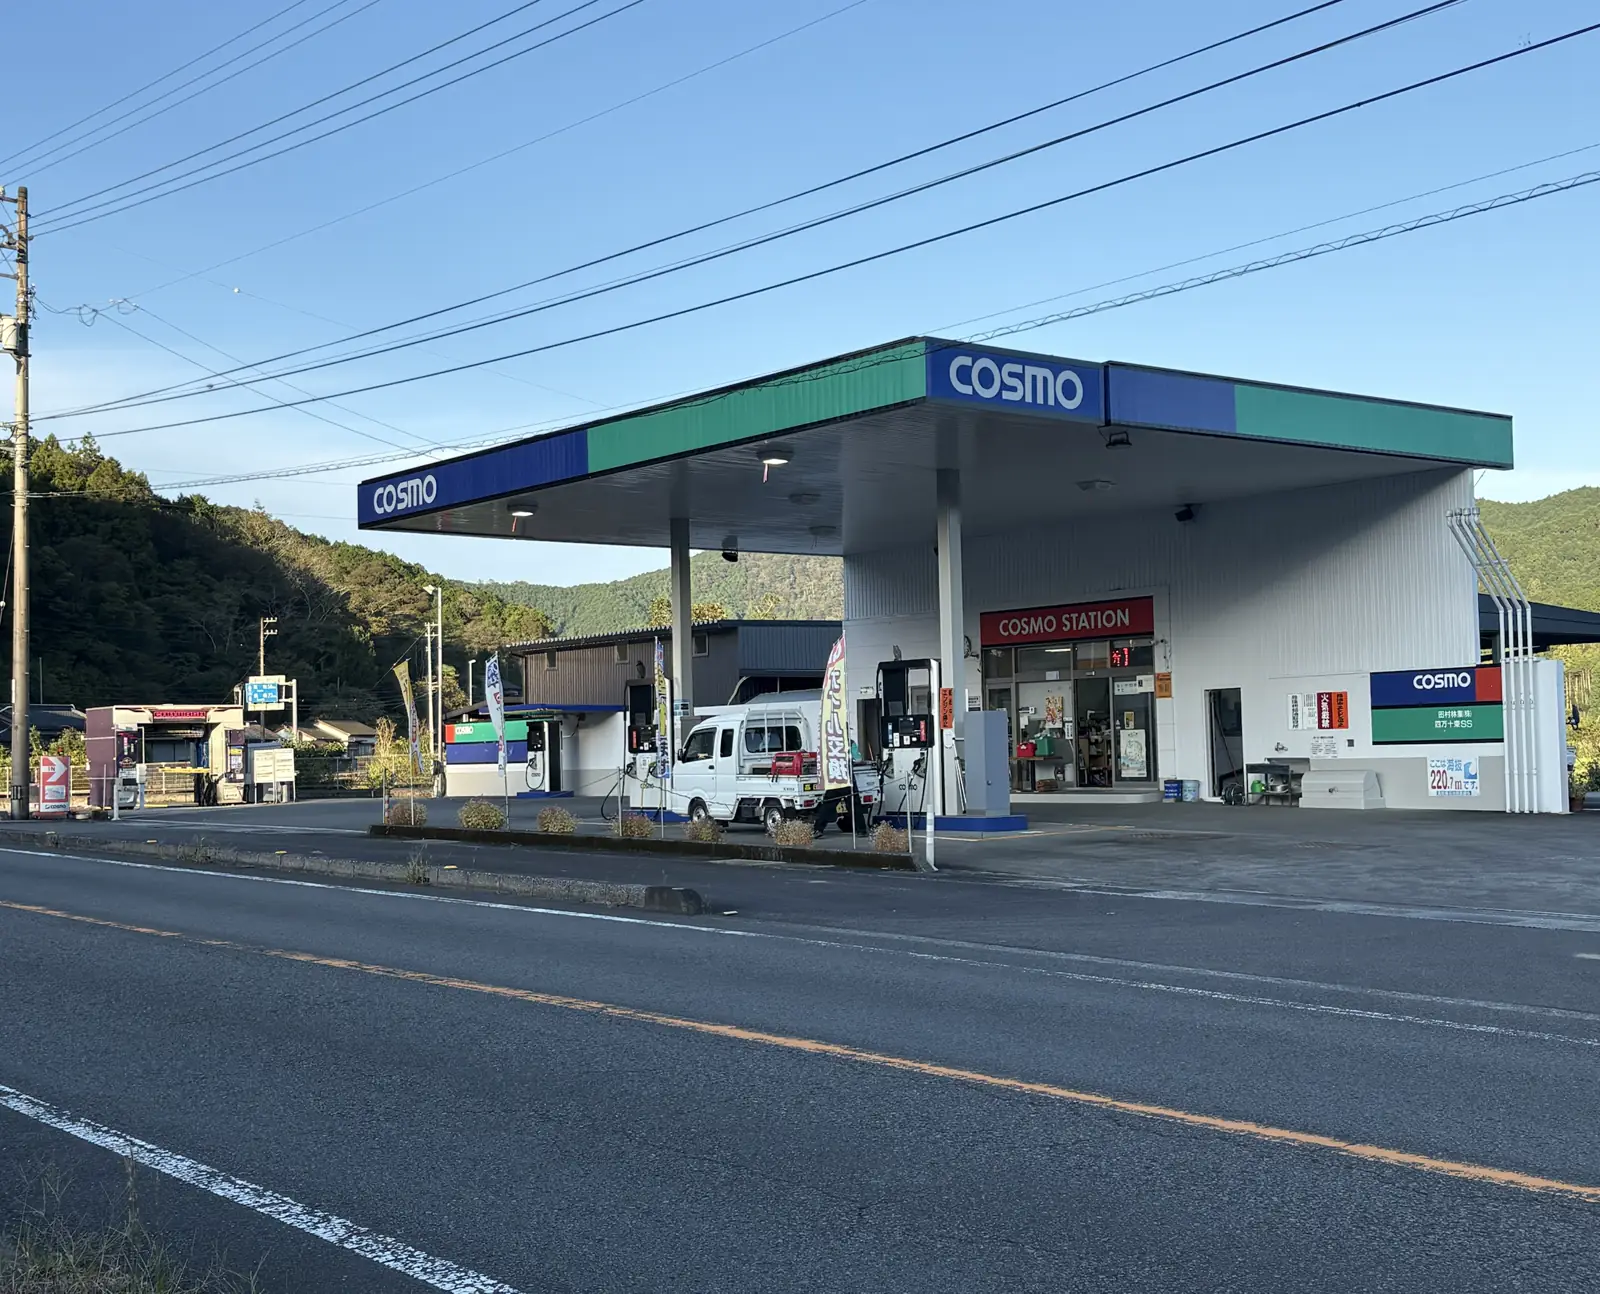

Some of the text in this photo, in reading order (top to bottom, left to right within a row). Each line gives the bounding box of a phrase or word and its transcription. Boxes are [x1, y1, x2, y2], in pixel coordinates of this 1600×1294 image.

[949, 355, 1084, 410] COSMO
[373, 474, 438, 515] COSMO
[999, 608, 1130, 637] COSMO STATION
[1413, 672, 1471, 689] COSMO
[1320, 693, 1330, 728] 火気厳禁
